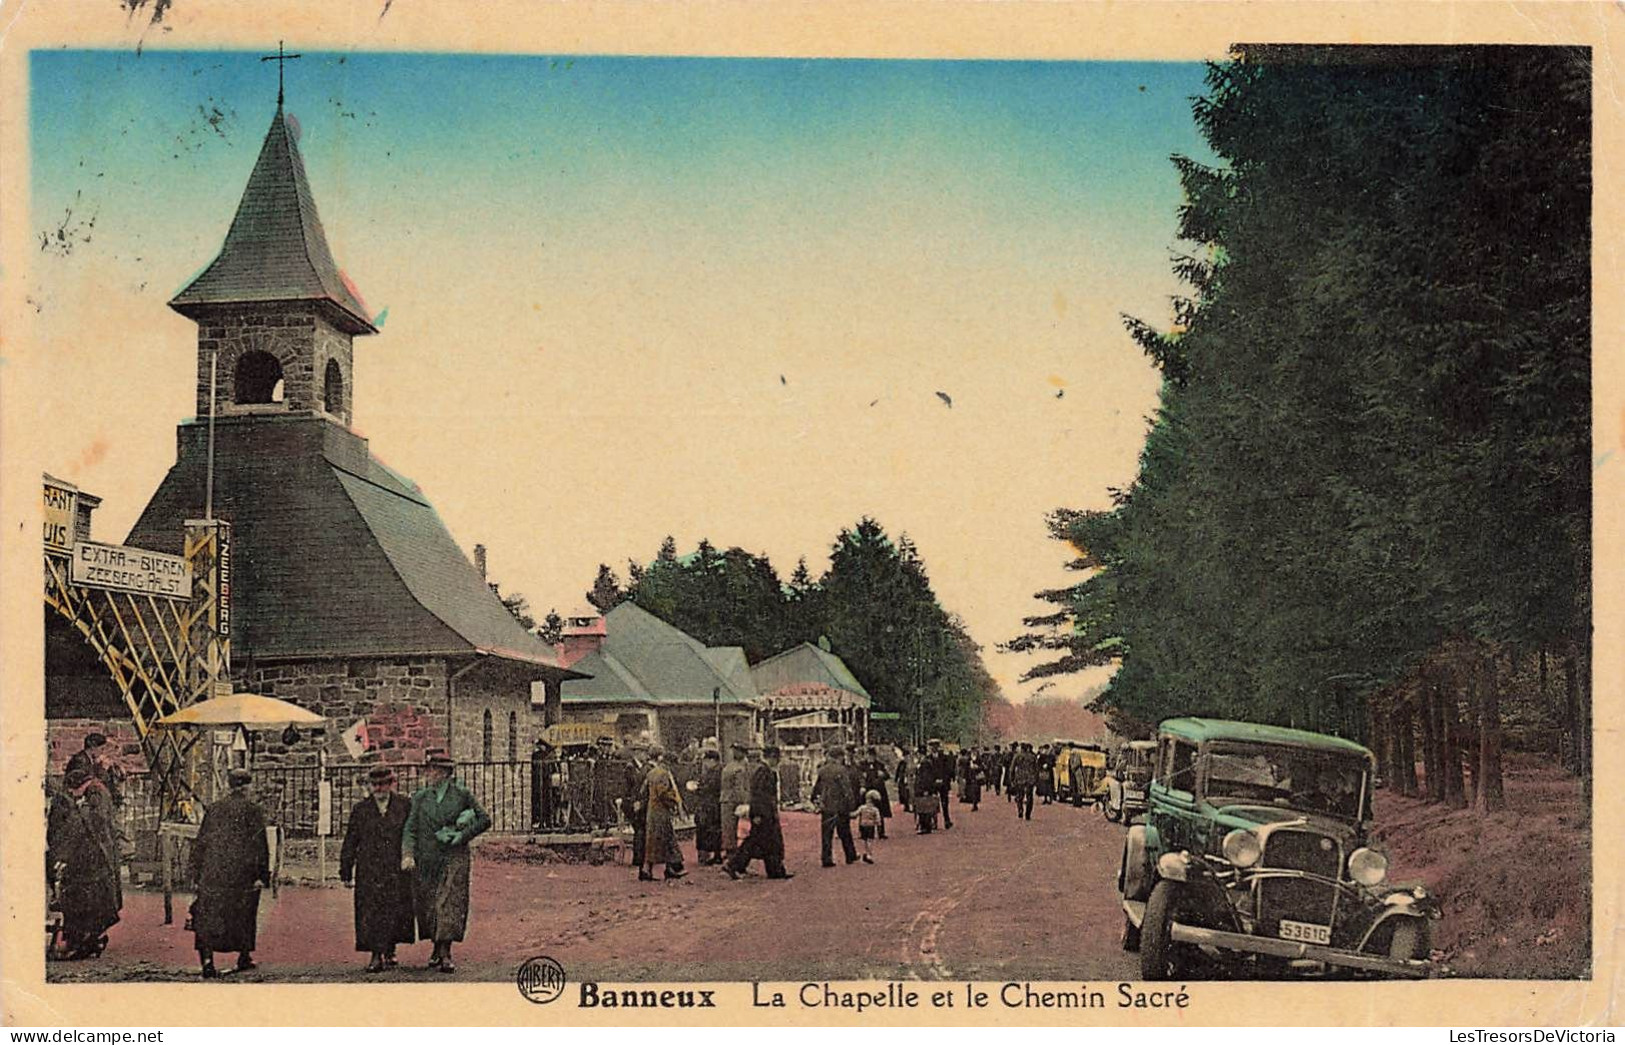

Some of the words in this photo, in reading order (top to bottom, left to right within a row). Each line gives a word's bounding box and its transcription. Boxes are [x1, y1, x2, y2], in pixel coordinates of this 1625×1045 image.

[81, 546, 125, 567] EXTRA
[140, 555, 186, 577] BIEREN
[578, 983, 716, 1008] Banneux
[753, 983, 787, 1007] La
[799, 982, 920, 1013] Chapelle
[931, 990, 955, 1008] et
[967, 983, 989, 1008] le
[1001, 982, 1105, 1008] Chemin
[1118, 982, 1190, 1009] Sacré
